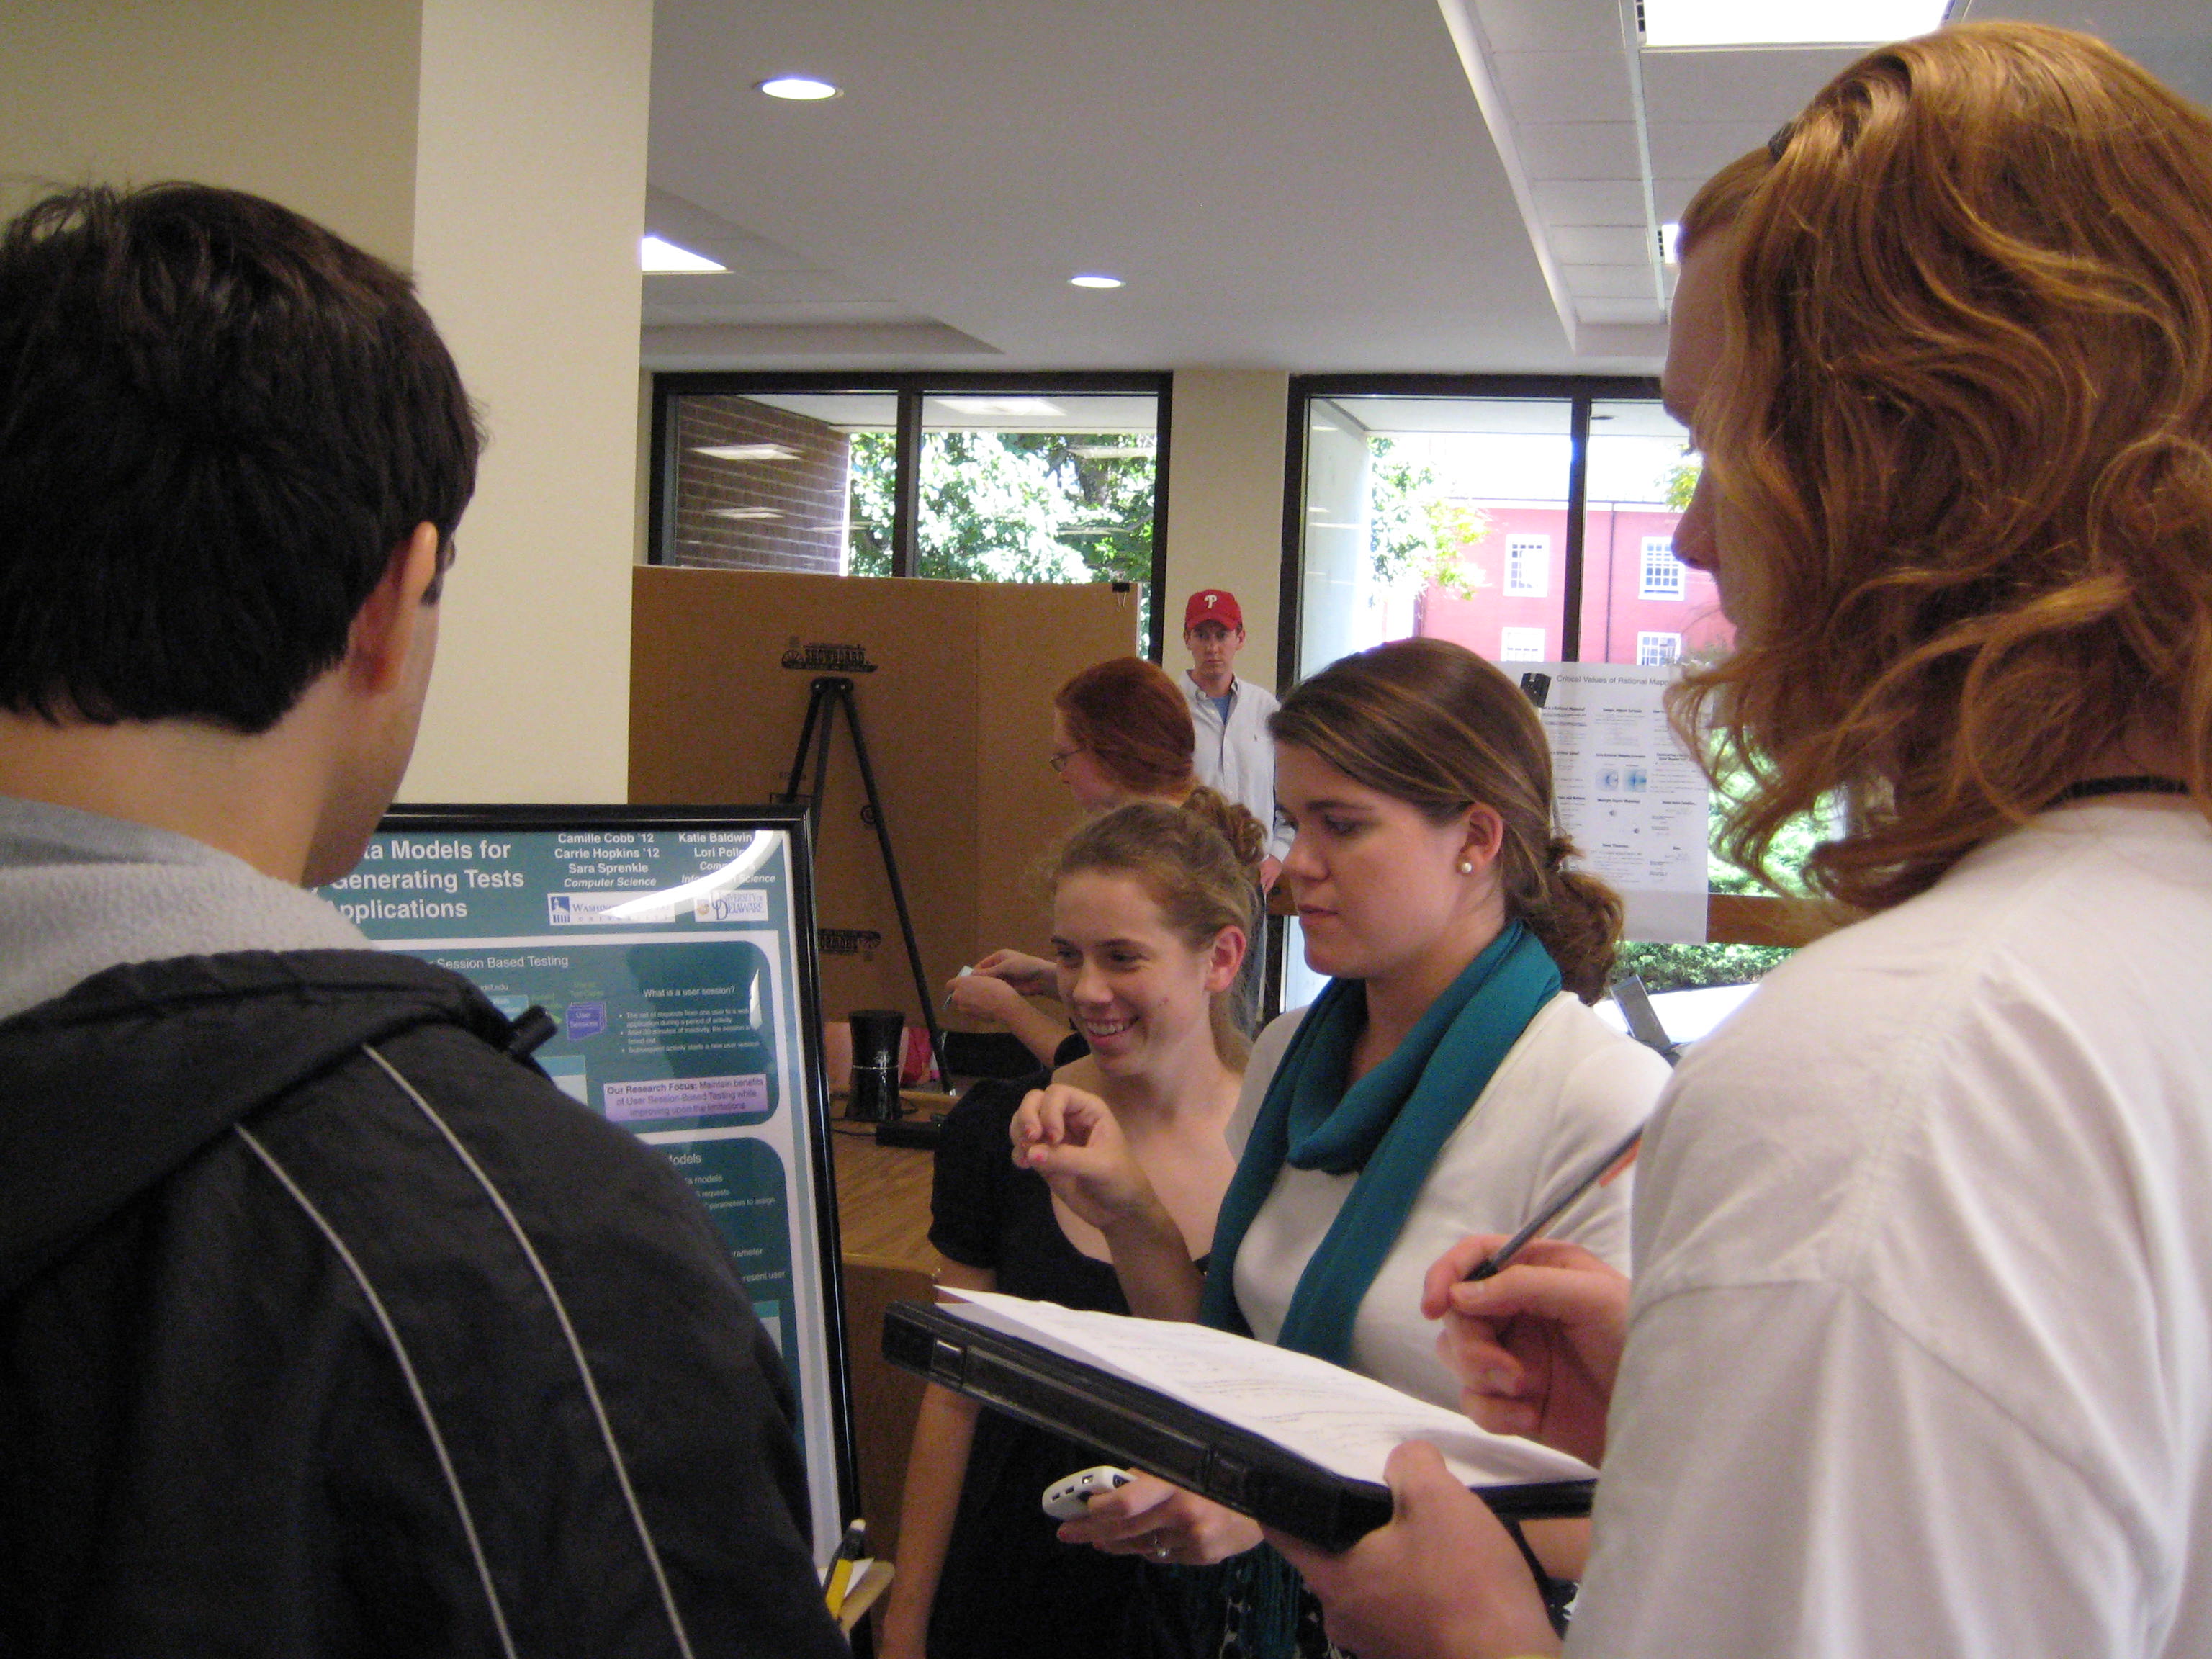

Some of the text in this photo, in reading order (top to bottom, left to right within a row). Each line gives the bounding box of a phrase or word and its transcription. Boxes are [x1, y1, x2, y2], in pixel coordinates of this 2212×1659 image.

[1204, 594, 1218, 609] P
[1556, 674, 1581, 683] Critical
[1649, 678, 1670, 687] Mapp
[557, 832, 655, 844] Camille Cobb '12
[678, 832, 753, 843] Katie Baldwin
[363, 839, 511, 860] ta Models for
[554, 848, 660, 860] Carrie Hopkins '12
[693, 846, 716, 858] Lori
[568, 862, 649, 876] Sara Sprenkle
[464, 868, 525, 888] Tests
[564, 877, 657, 889] Computer Science
[437, 955, 569, 970] Session Based Testing
[643, 988, 665, 997] What
[702, 985, 736, 995] session?
[607, 1086, 624, 1095] Our
[626, 1084, 667, 1094] Research
[668, 1082, 698, 1091] Focus:
[699, 1079, 732, 1089] Maintain
[616, 1097, 625, 1106] of
[626, 1095, 646, 1105] User
[709, 1092, 736, 1102] Testing
[695, 1174, 724, 1184] models
[733, 1247, 763, 1257] rameter
[742, 1272, 786, 1282] resent user
